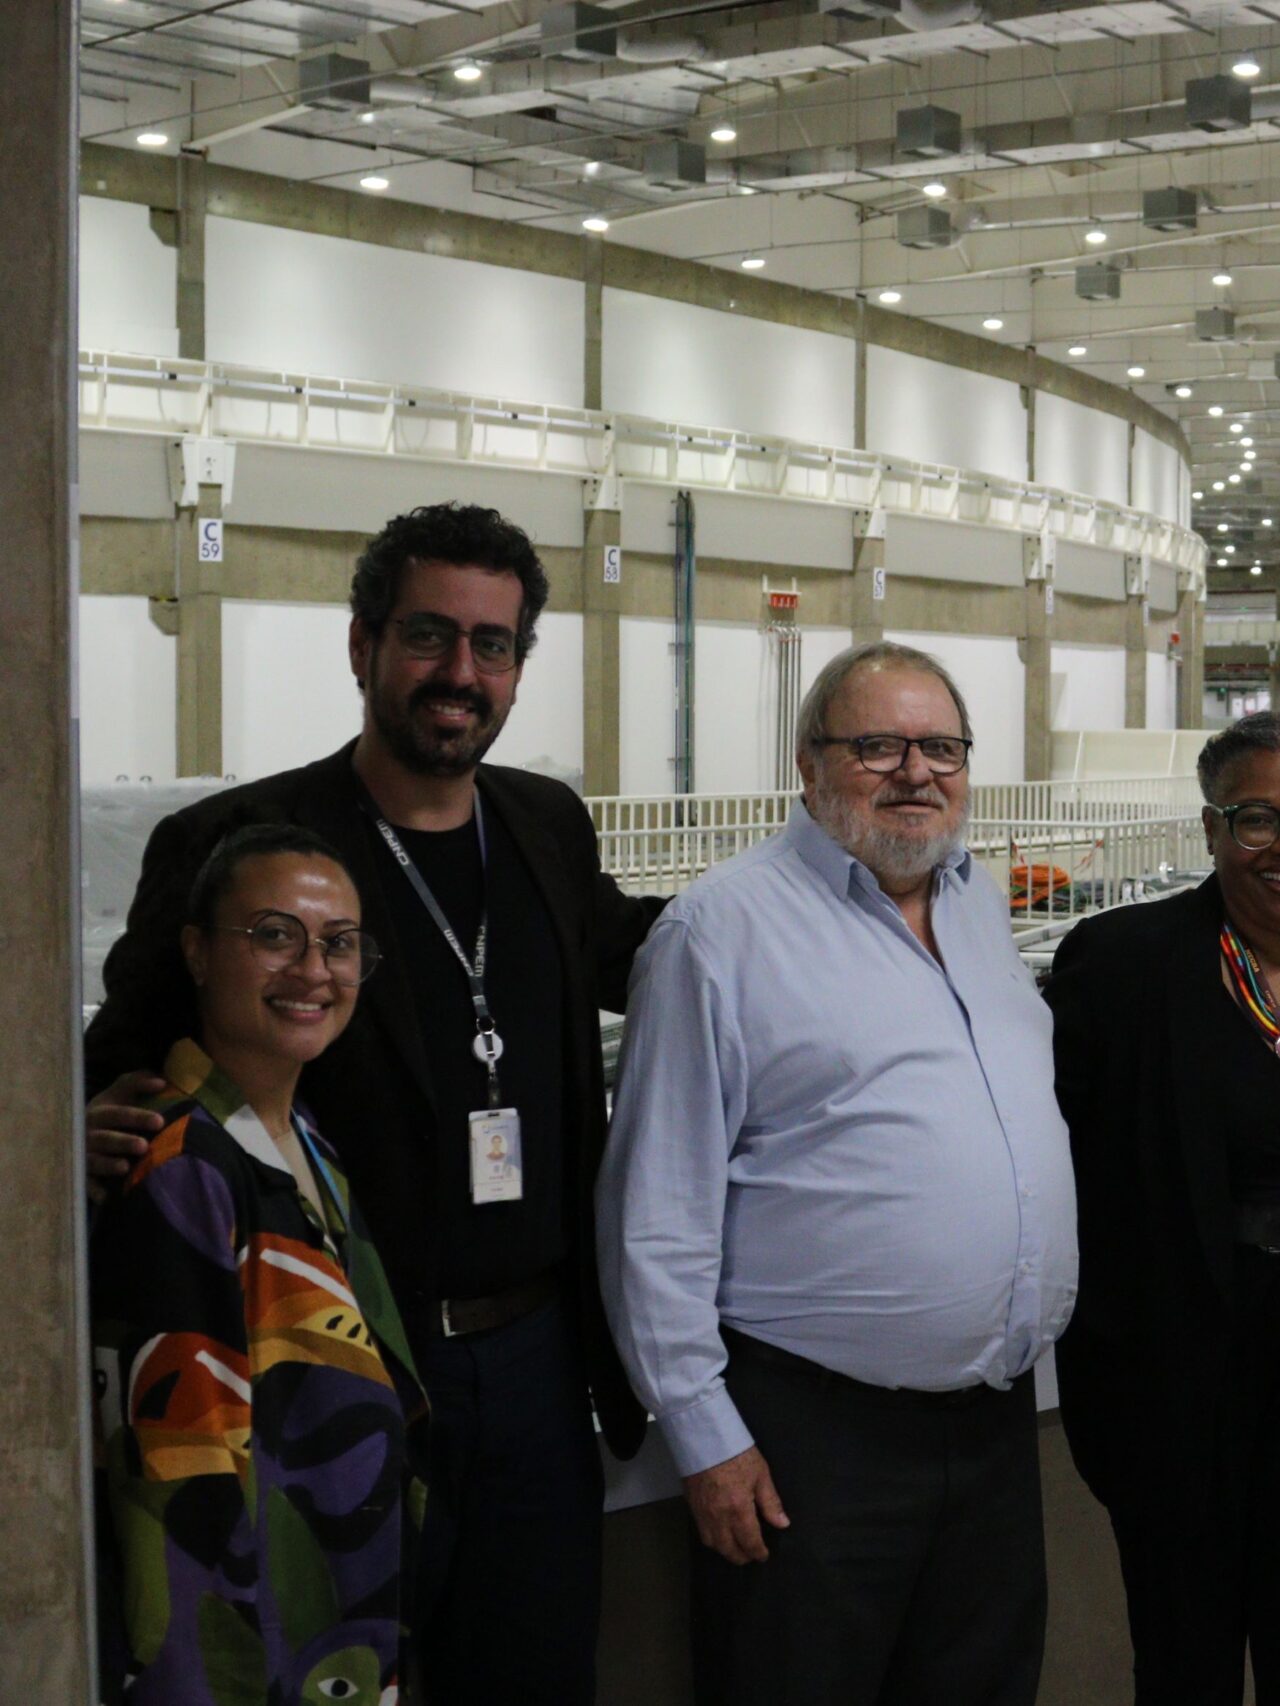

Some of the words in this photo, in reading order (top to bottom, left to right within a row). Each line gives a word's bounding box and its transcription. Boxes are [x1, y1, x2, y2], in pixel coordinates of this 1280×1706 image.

[204, 522, 217, 542] C
[201, 542, 220, 559] 59
[608, 549, 617, 566] C
[876, 570, 882, 585] C
[375, 819, 409, 866] CNPEM
[443, 929, 475, 977] CNPEM
